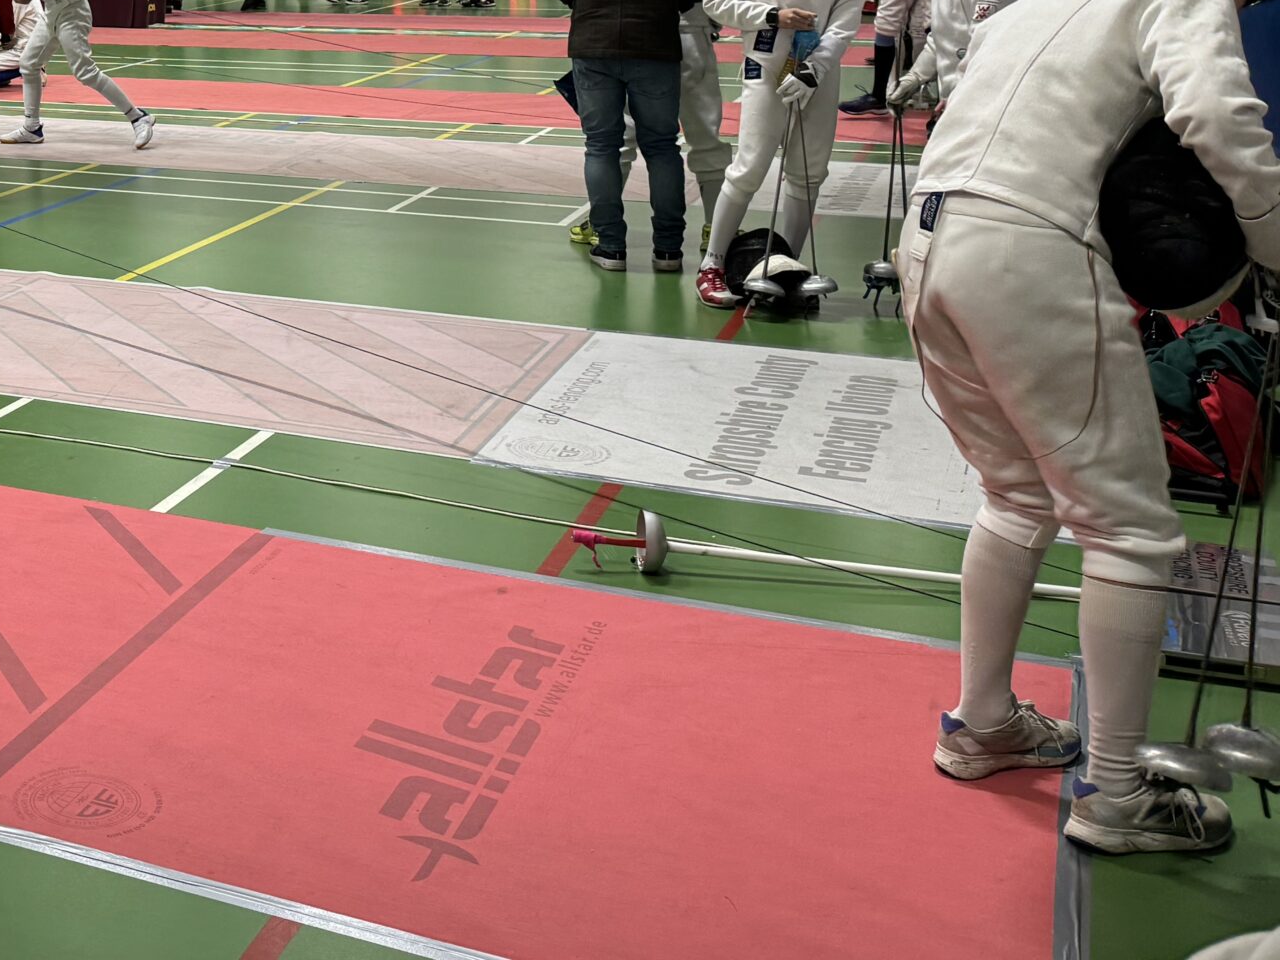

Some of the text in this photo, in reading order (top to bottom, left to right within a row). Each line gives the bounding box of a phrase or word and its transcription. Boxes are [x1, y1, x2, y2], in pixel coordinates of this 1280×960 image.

[683, 354, 819, 486] Shropshire County
[797, 375, 899, 483] Fencing Union
[534, 619, 608, 719] www.allstar.de
[353, 624, 566, 836] allstar
